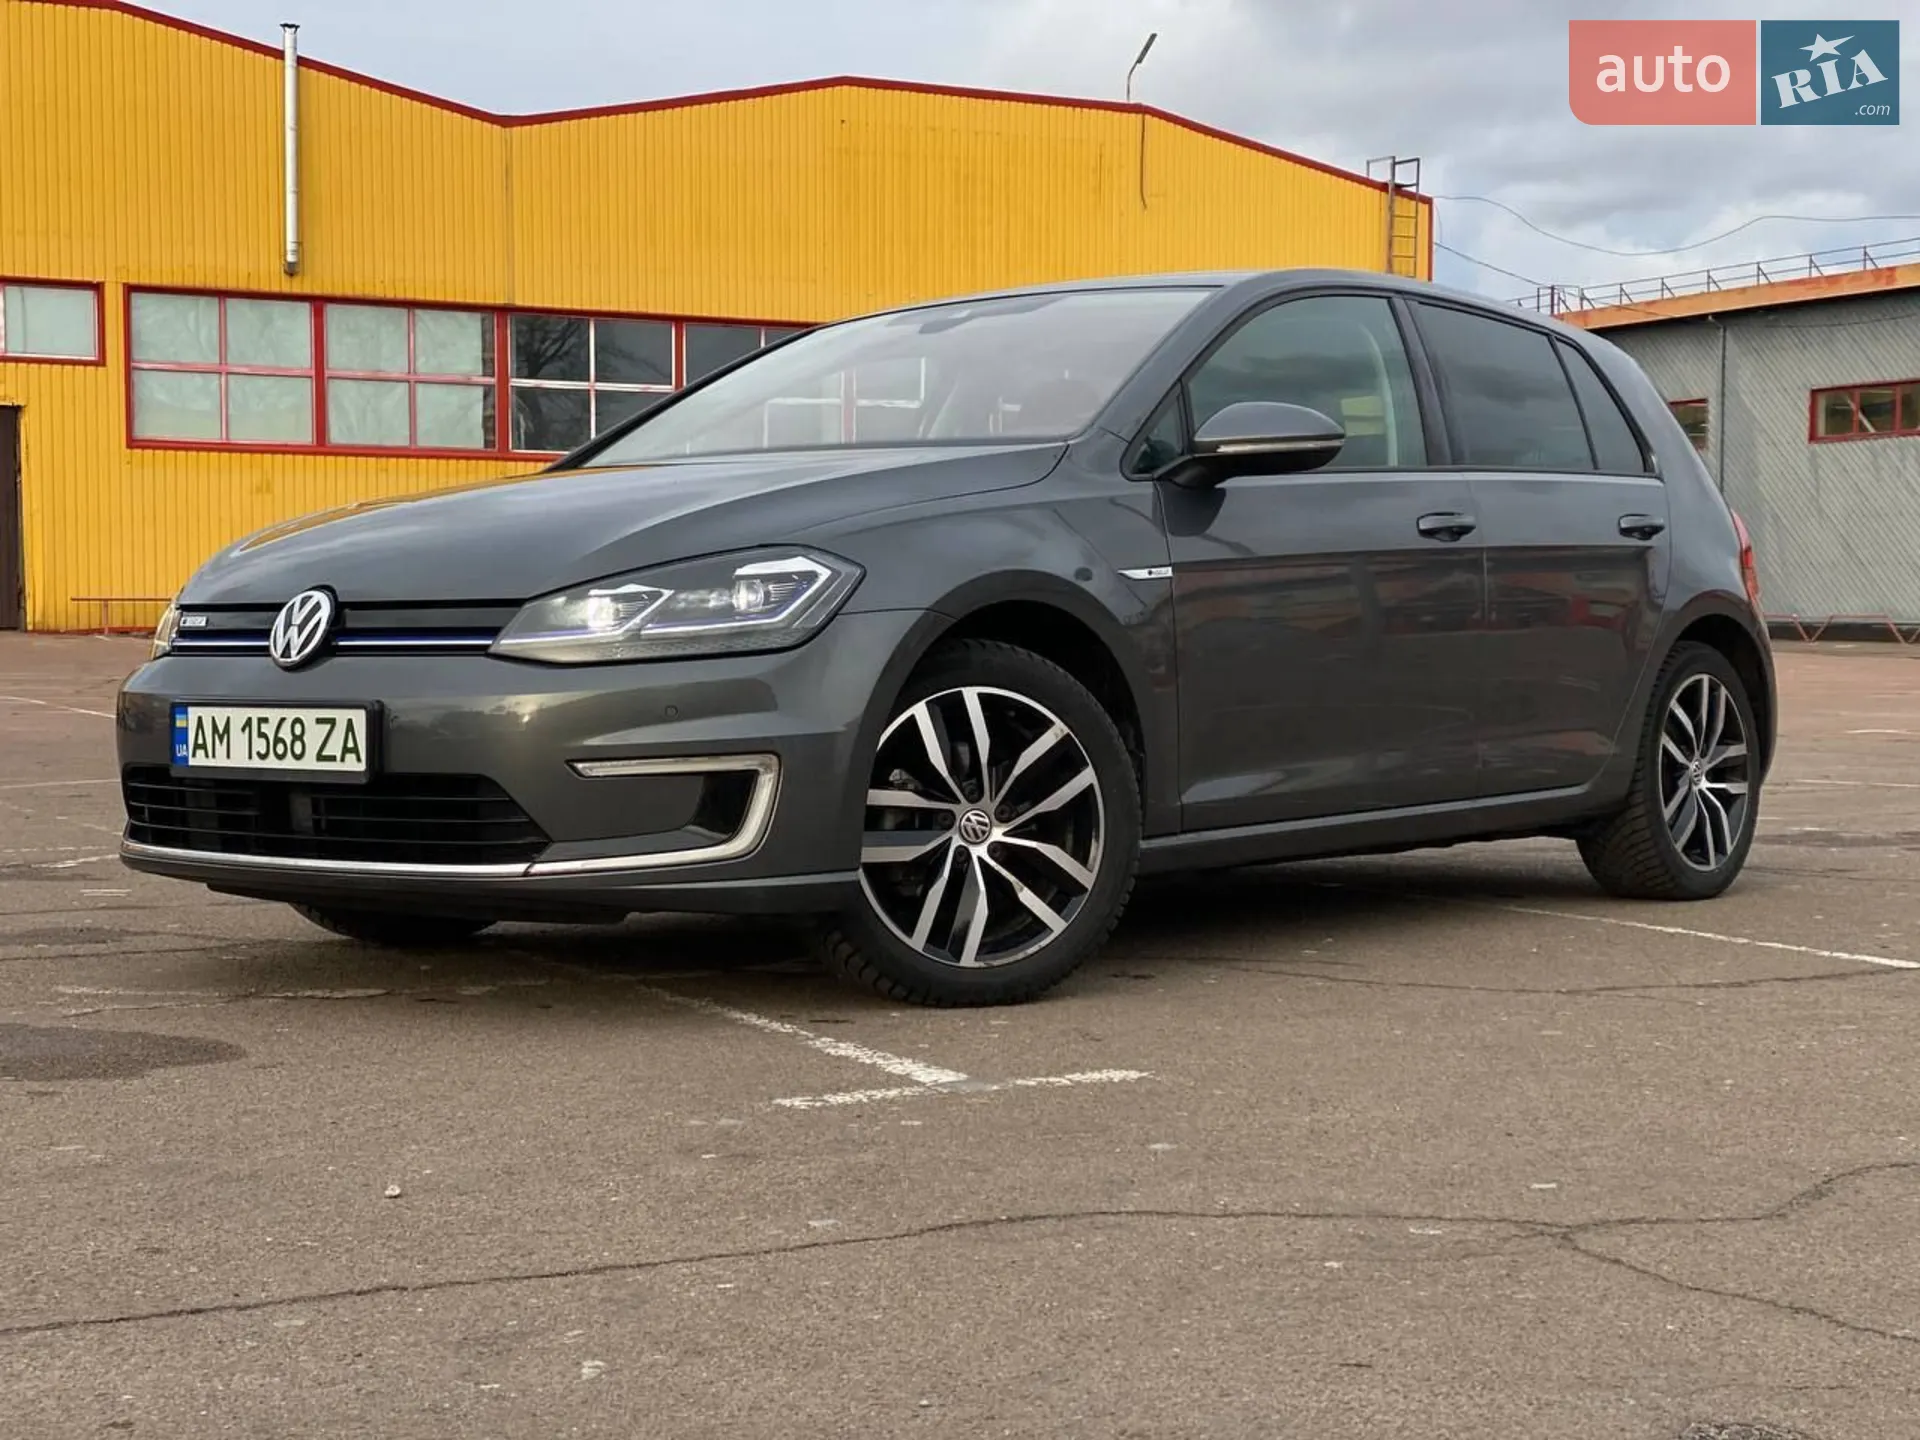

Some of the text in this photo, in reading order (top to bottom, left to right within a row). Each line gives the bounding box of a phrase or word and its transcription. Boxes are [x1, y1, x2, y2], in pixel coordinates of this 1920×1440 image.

[175, 744, 188, 757] UA
[191, 715, 363, 763] AM 1568 ZA
